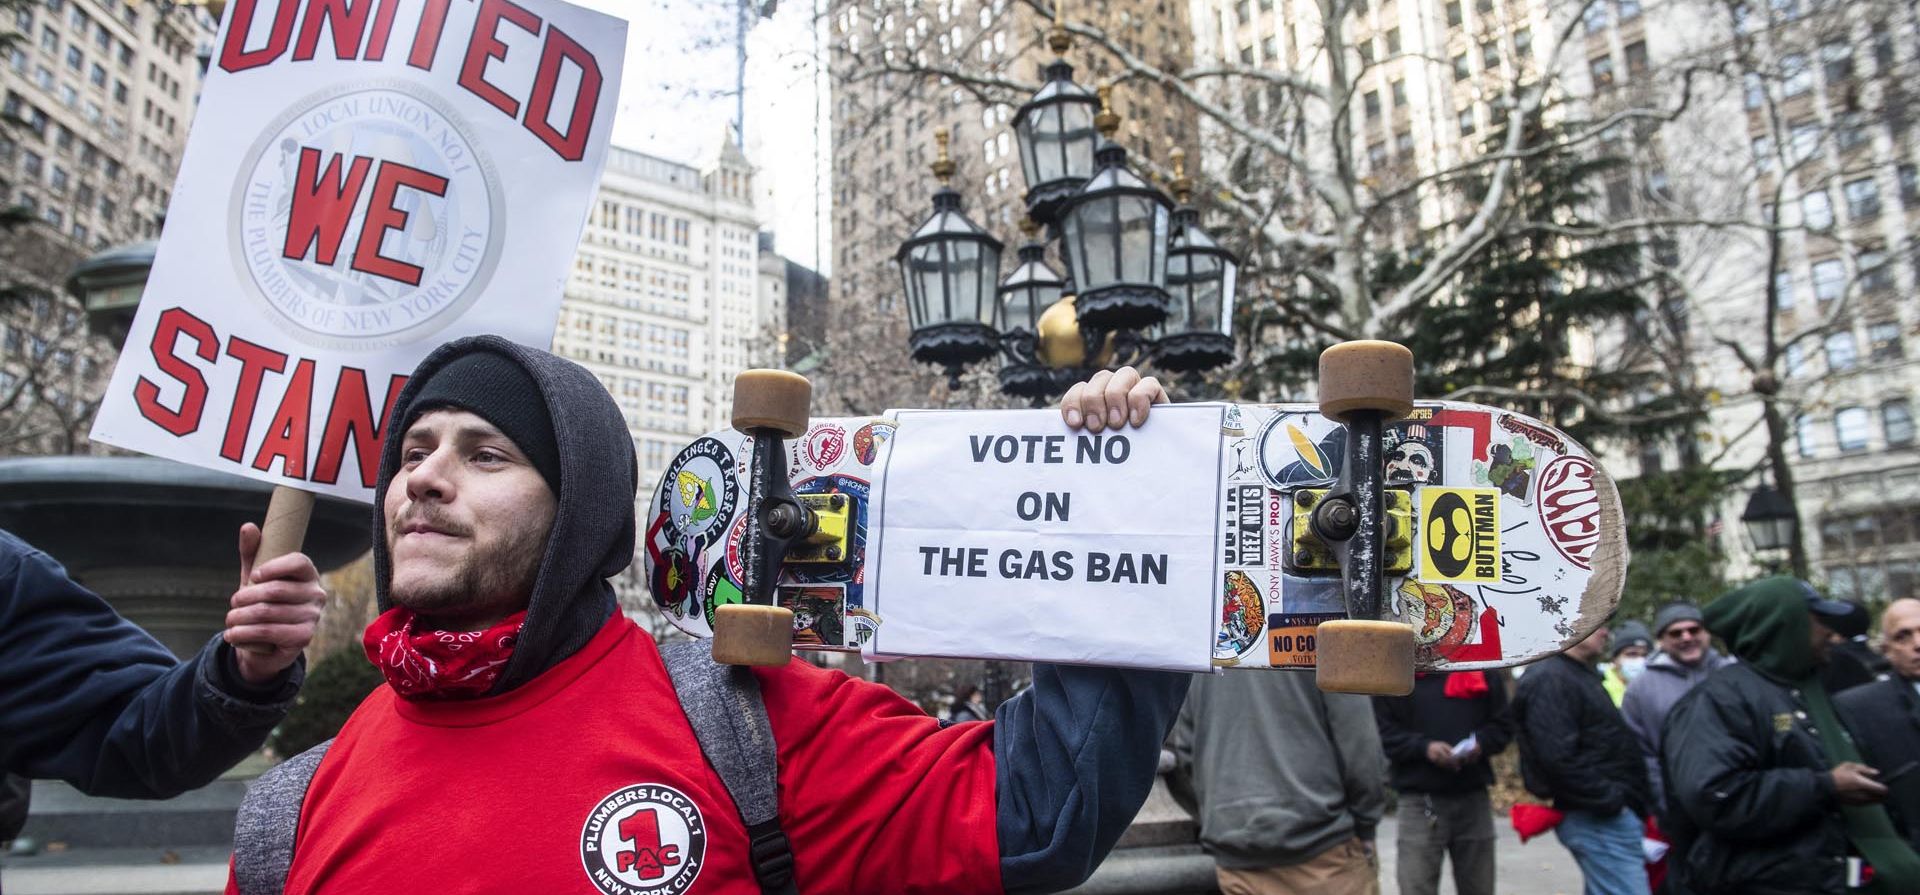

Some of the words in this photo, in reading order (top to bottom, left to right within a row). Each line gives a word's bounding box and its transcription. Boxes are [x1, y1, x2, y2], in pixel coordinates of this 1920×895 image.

[218, 0, 603, 161] UNITED
[302, 99, 359, 137] LOCAL
[369, 97, 431, 132] UNION
[246, 181, 274, 221] THE
[282, 146, 449, 286] WE
[452, 226, 482, 274] CITY
[248, 227, 309, 317] PLUMBERS
[400, 275, 459, 319] YORK
[312, 307, 336, 328] OF
[342, 307, 391, 330] NEW
[816, 427, 847, 471] CANNERY
[969, 435, 1065, 463] VOTE
[1075, 435, 1131, 464] NO
[1016, 491, 1071, 522] ON
[1242, 488, 1261, 525] NUTS
[1243, 530, 1262, 562] DEEZ
[1269, 529, 1280, 572] HAWK'S
[1475, 494, 1495, 578] BUTTMAN
[706, 572, 719, 596] day!
[919, 546, 988, 577] THE
[999, 549, 1074, 581] GAS
[1086, 552, 1168, 584] BAN
[1269, 574, 1280, 604] TONY
[1273, 635, 1293, 652] NO
[1292, 655, 1313, 663] VOTE
[586, 788, 648, 852] PLUMBERS
[650, 789, 697, 827] LOCAL
[692, 828, 702, 836] 1
[594, 867, 627, 895] NEW
[674, 857, 698, 889] CITY
[616, 844, 680, 873] PAC
